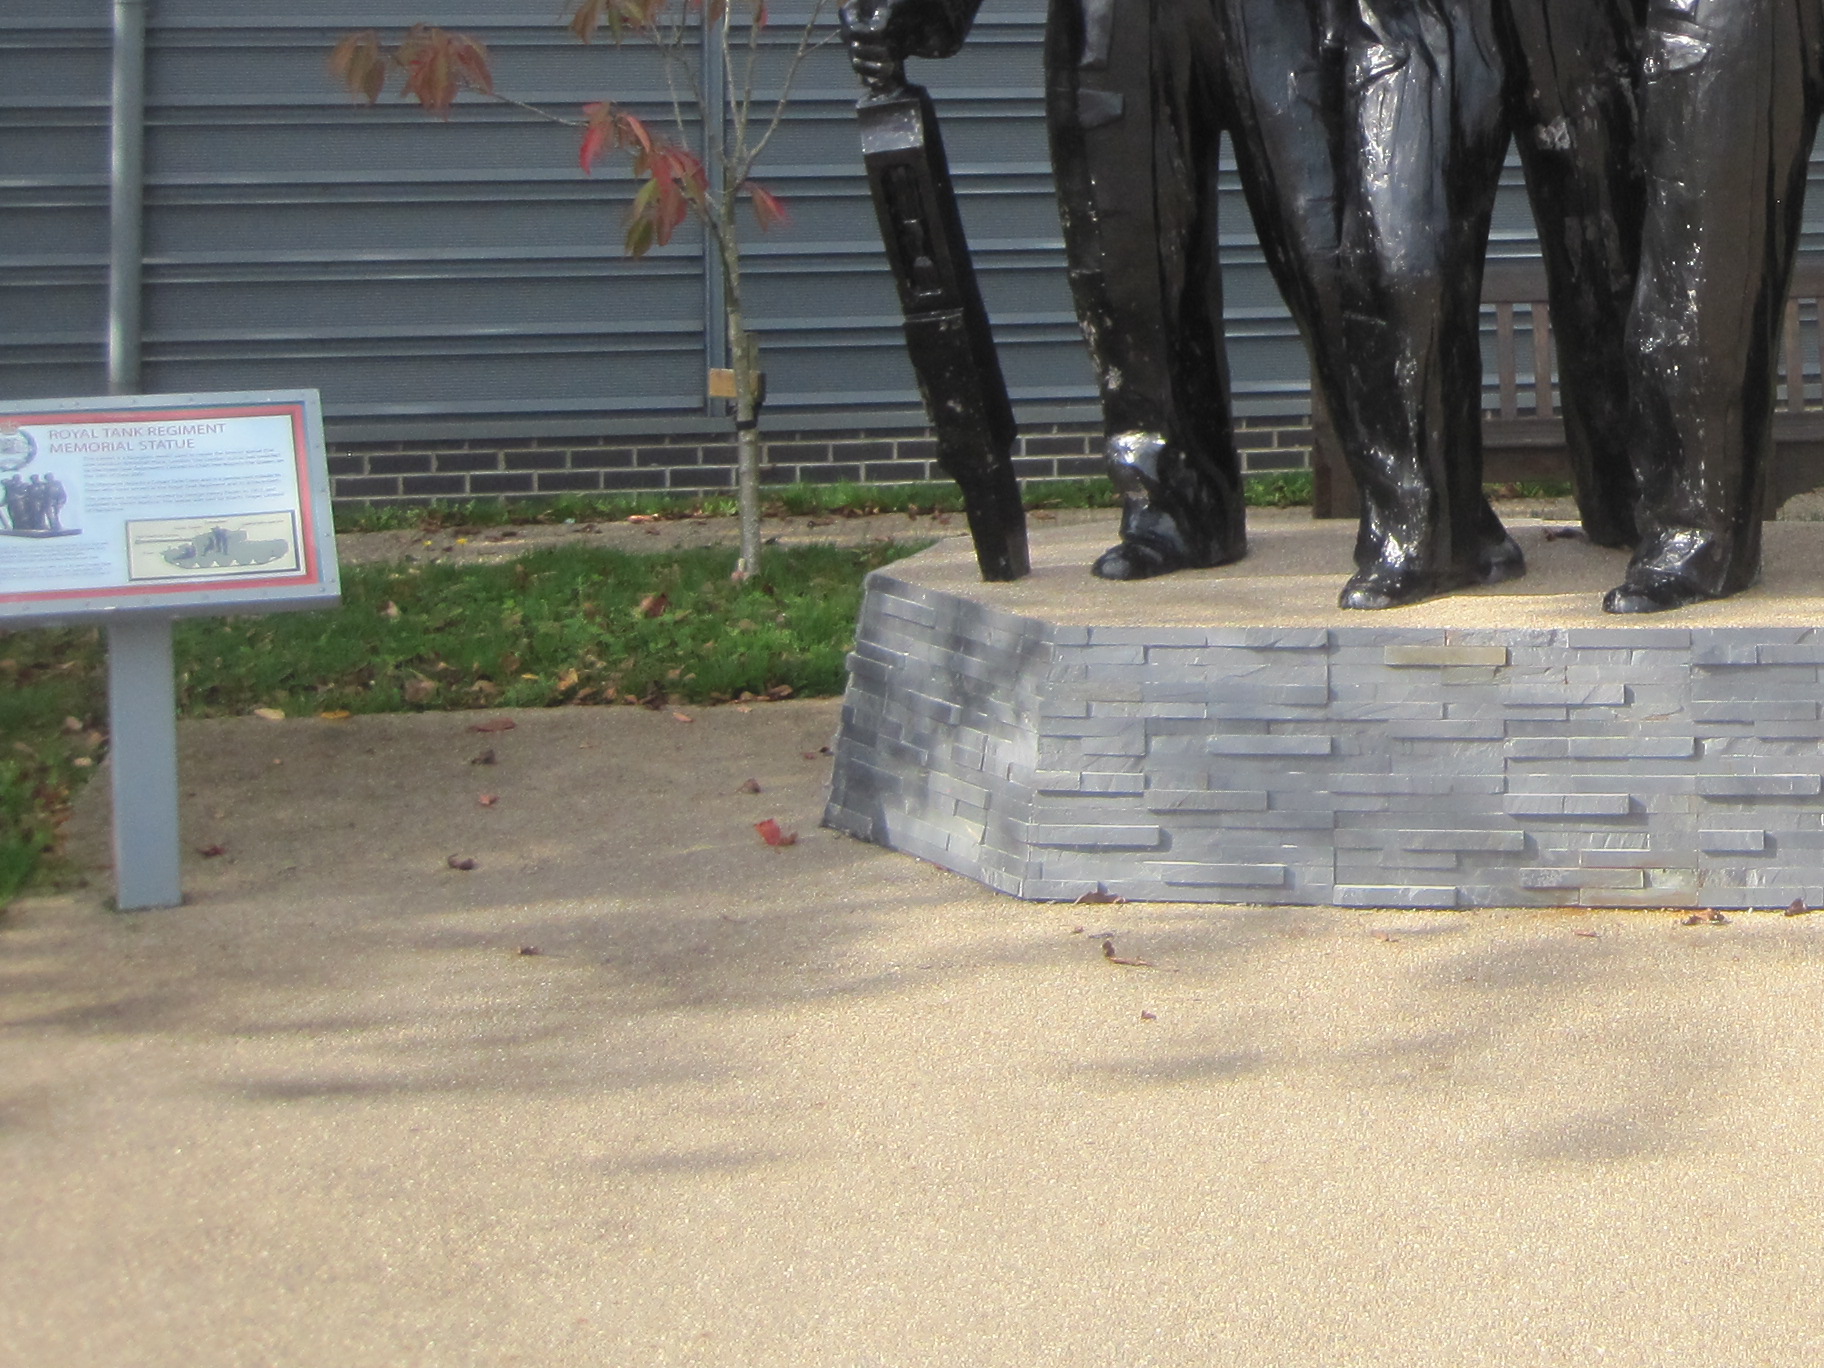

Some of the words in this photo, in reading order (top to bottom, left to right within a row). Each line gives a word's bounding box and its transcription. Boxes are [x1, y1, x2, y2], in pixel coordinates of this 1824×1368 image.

[49, 428, 98, 440] ROYAL
[103, 427, 142, 438] TANK
[148, 423, 226, 436] REGIMENT
[50, 442, 134, 453] MEMORIAL
[139, 438, 195, 451] STATUE
